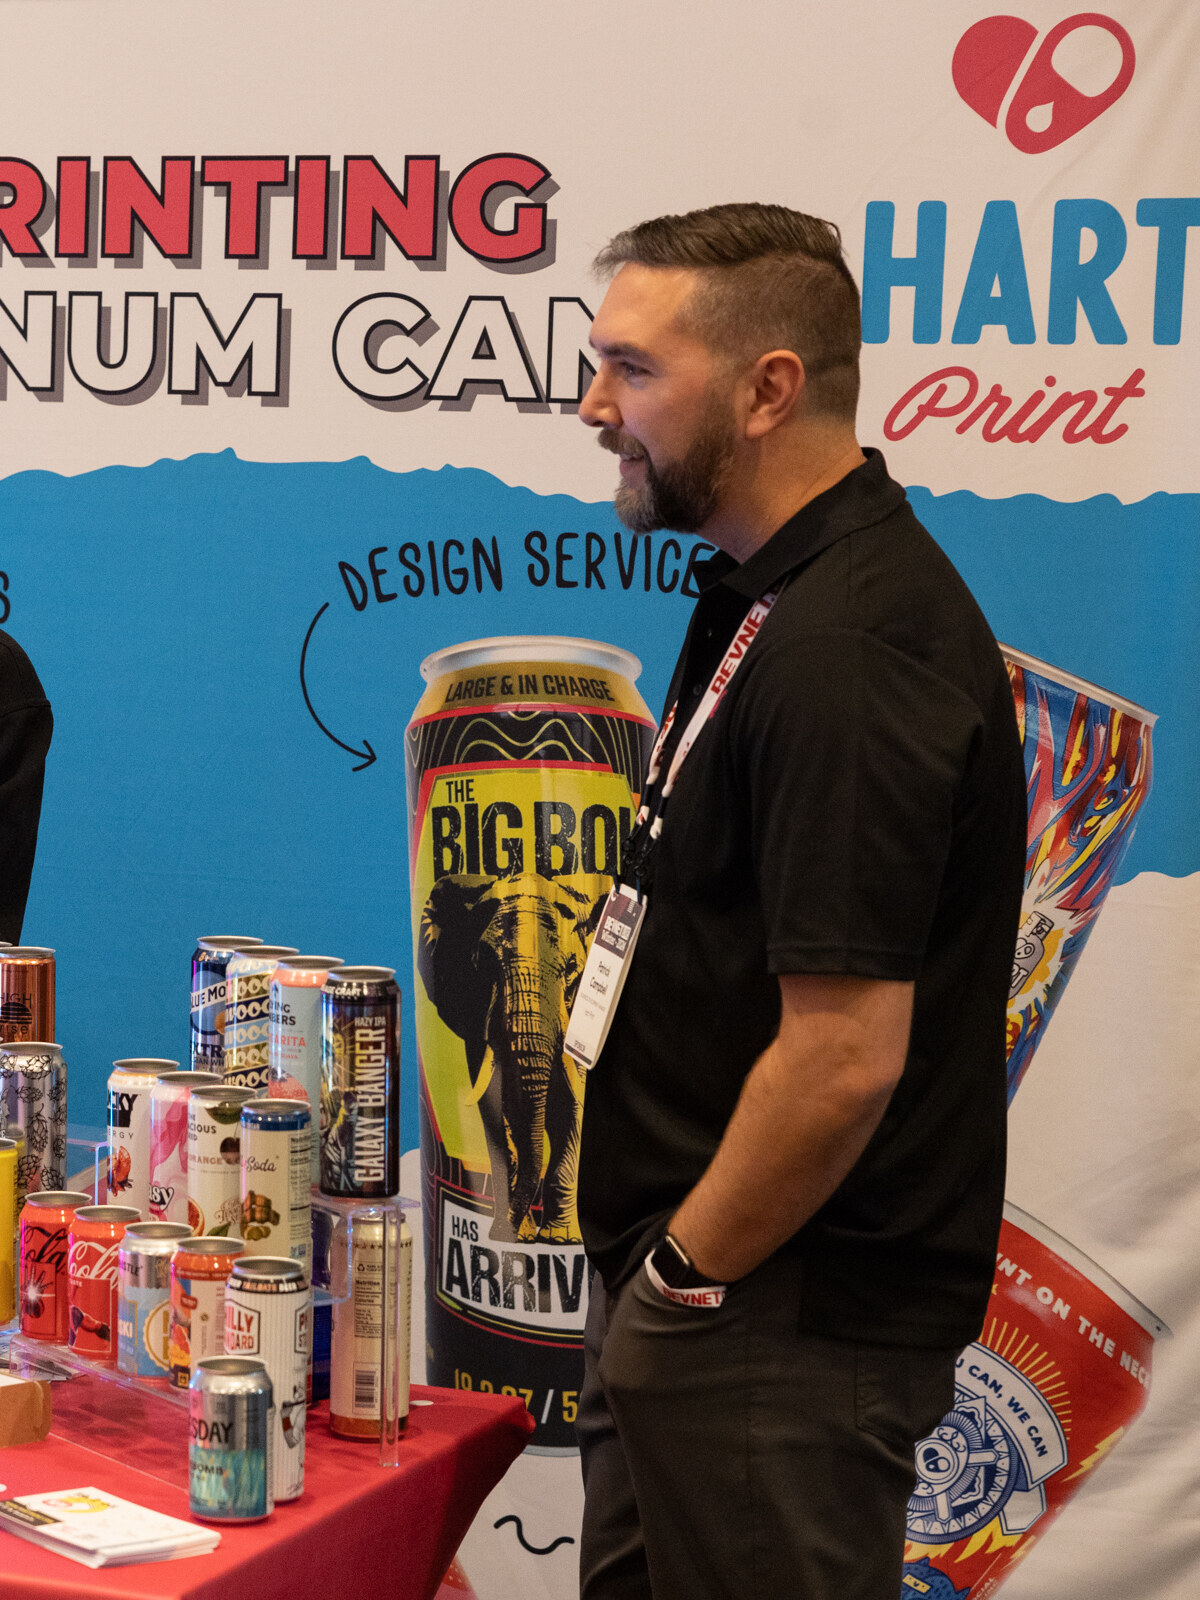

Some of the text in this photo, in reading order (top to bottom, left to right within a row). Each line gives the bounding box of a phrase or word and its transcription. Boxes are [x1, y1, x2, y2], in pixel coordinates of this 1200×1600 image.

[861, 197, 1200, 347] HART
[882, 365, 1146, 446] Print
[337, 536, 504, 612] DESIGN
[445, 673, 616, 703] LARGE & IN CHARGE
[445, 778, 476, 803] THE
[430, 802, 525, 884] BIG
[354, 1016, 387, 1026] HAZY IPA
[353, 1027, 386, 1182] GALAXY BANGER
[245, 1155, 278, 1173] Soda
[451, 1214, 480, 1243] HAS
[445, 1237, 593, 1314] ARRIV
[1035, 1286, 1072, 1321] ON
[1077, 1314, 1117, 1359] THE
[968, 1364, 1004, 1400] CAN,
[1007, 1395, 1032, 1425] WE
[1026, 1425, 1049, 1458] CAN
